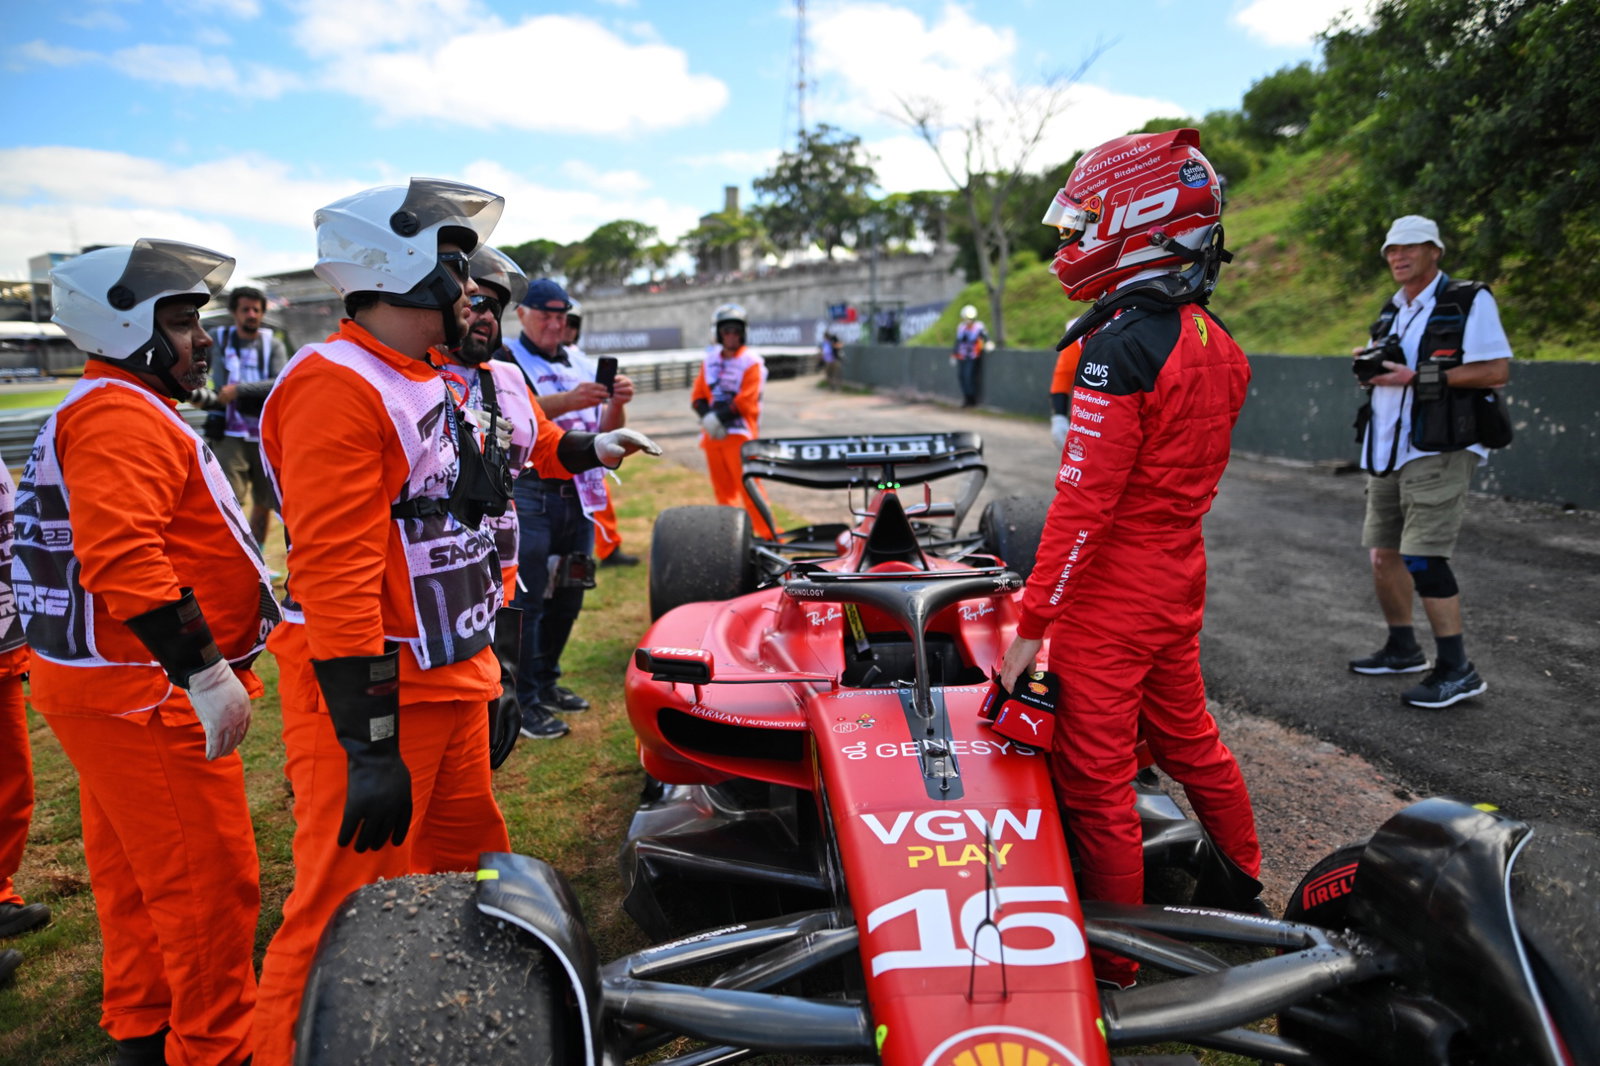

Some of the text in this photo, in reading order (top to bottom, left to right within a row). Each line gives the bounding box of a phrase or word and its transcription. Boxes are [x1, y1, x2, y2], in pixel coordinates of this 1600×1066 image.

[1086, 142, 1152, 177] Santander
[1113, 155, 1162, 180] Bitdefender
[1084, 361, 1110, 379] aws
[807, 607, 843, 627] Ray-Ban
[958, 602, 995, 622] Ray-Ban
[690, 705, 808, 729] HARMAN AUTOMOTIVE
[859, 808, 1043, 845] VGW
[907, 843, 1014, 868] PLAY
[867, 886, 1086, 978] 16
